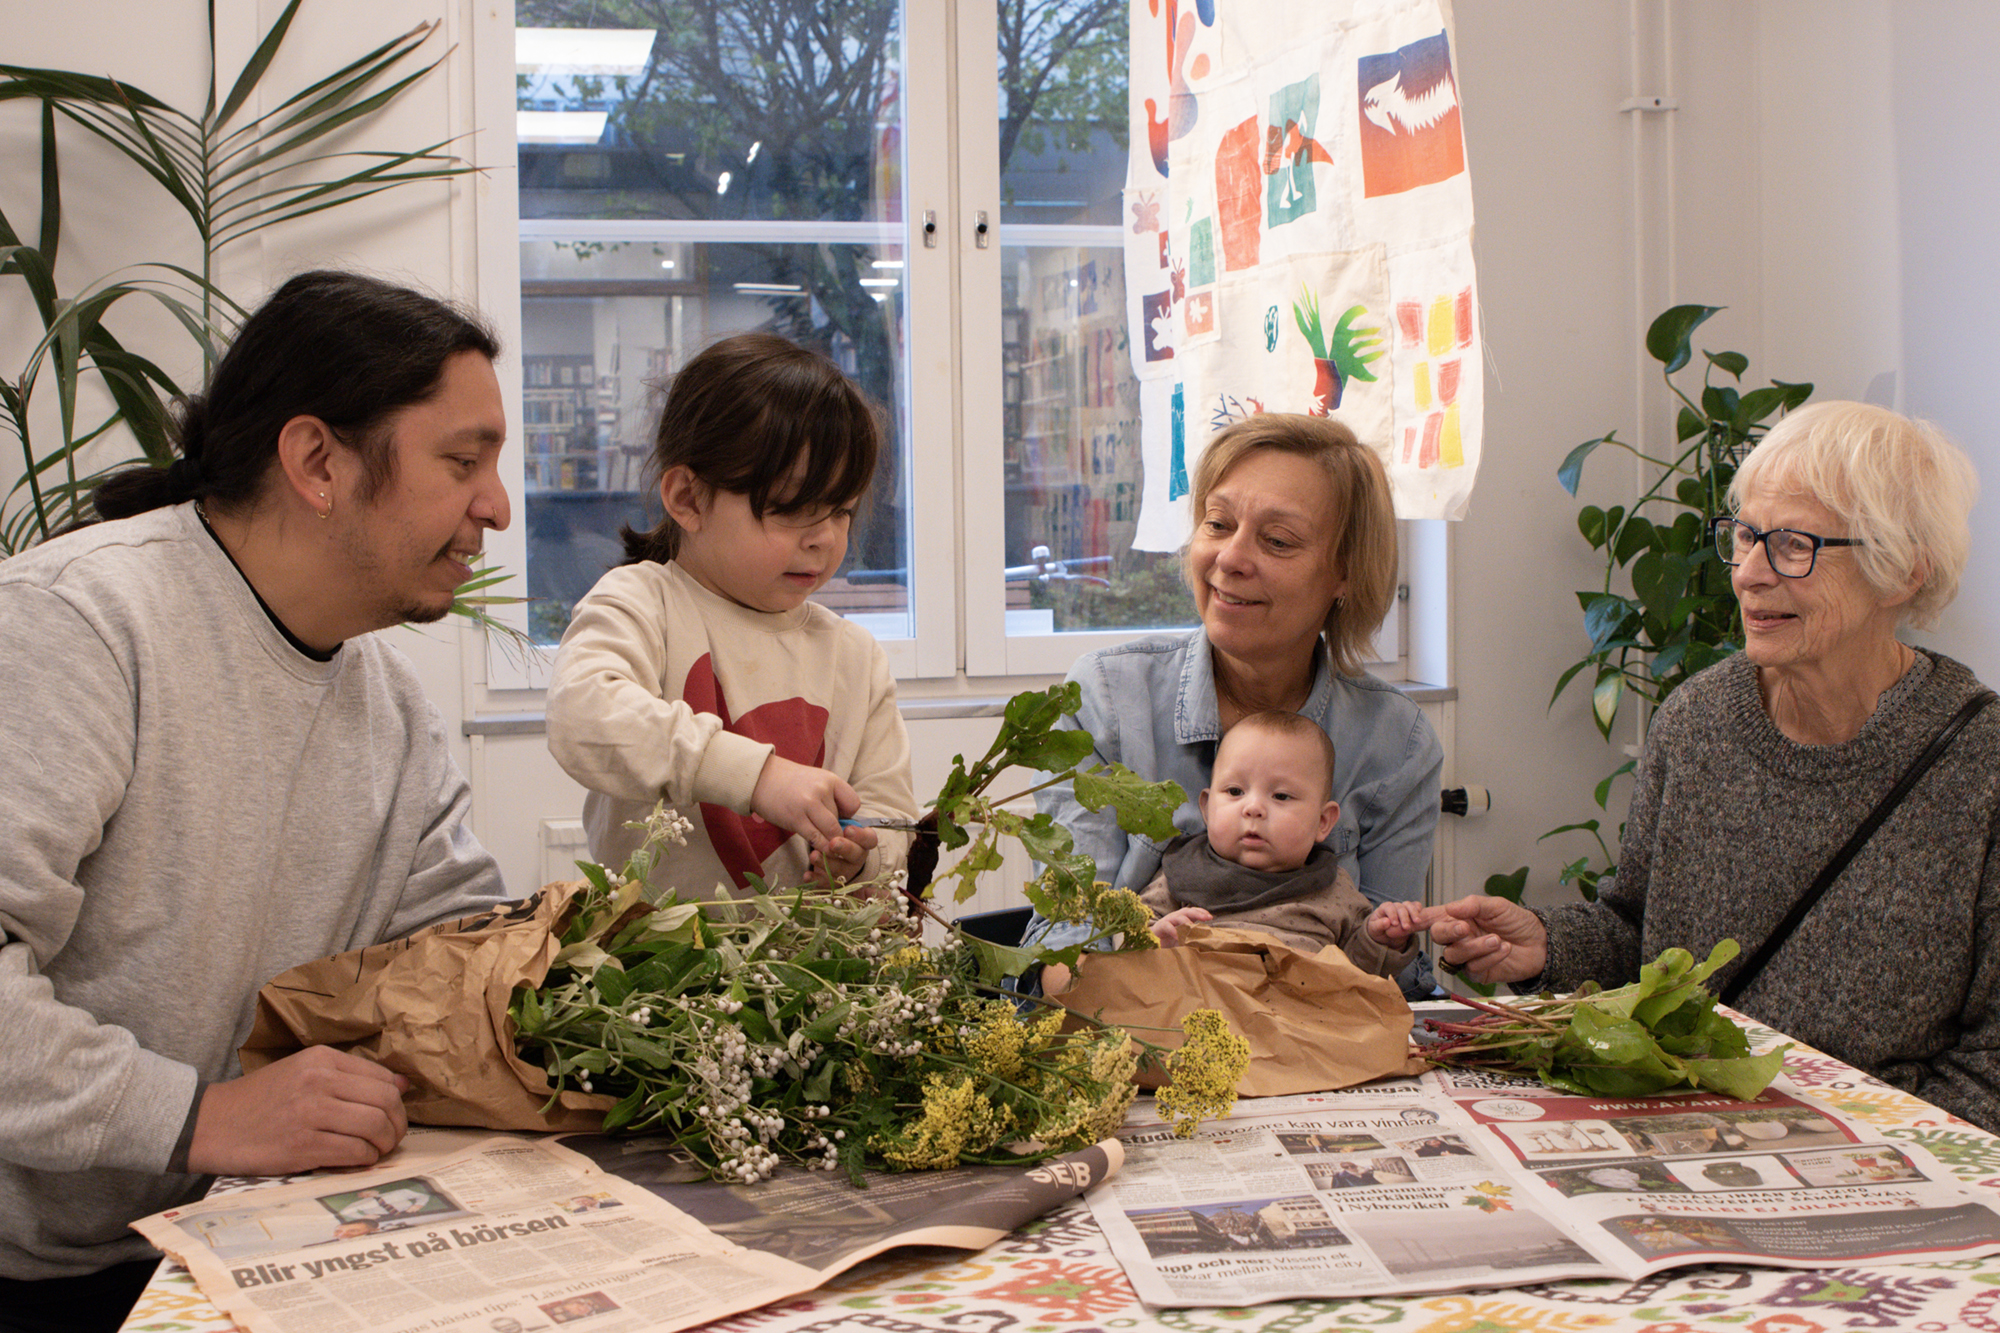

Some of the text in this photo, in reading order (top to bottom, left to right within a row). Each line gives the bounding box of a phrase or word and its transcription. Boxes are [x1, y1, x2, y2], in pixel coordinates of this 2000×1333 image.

[1589, 1096, 1772, 1111] WWW.AVAHT.E
[1200, 1122, 1284, 1138] Snoozare
[1288, 1120, 1323, 1129] kan
[1327, 1118, 1367, 1129] vara
[1371, 1117, 1439, 1128] vinnare
[1025, 1160, 1091, 1190] SEB
[1327, 1185, 1467, 1198] Höstdimman ger
[1333, 1192, 1447, 1204] vinterkänslor
[1655, 1197, 1785, 1205] HEMLEVERANS
[1790, 1194, 1856, 1202] SAMMA
[1861, 1190, 1916, 1199] KVÄLL
[1823, 1187, 1869, 1195] 12:00
[1349, 1201, 1450, 1212] Nybroviken
[1666, 1205, 1748, 1213] GÄLLER
[1788, 1200, 1894, 1212] JULAFTON
[231, 1263, 296, 1289] Blir
[301, 1242, 405, 1279] yngst
[406, 1232, 452, 1258] på
[449, 1214, 570, 1247] börsen
[1156, 1263, 1192, 1274] Upp
[1198, 1258, 1231, 1269] och
[1274, 1255, 1327, 1265] Vissen
[1331, 1251, 1350, 1260] ek
[1161, 1271, 1213, 1281] svävar
[1217, 1264, 1270, 1278] mellan
[1273, 1261, 1322, 1272] husen
[1334, 1258, 1363, 1270] city
[431, 1310, 481, 1328] bästa
[484, 1299, 522, 1314] tips:
